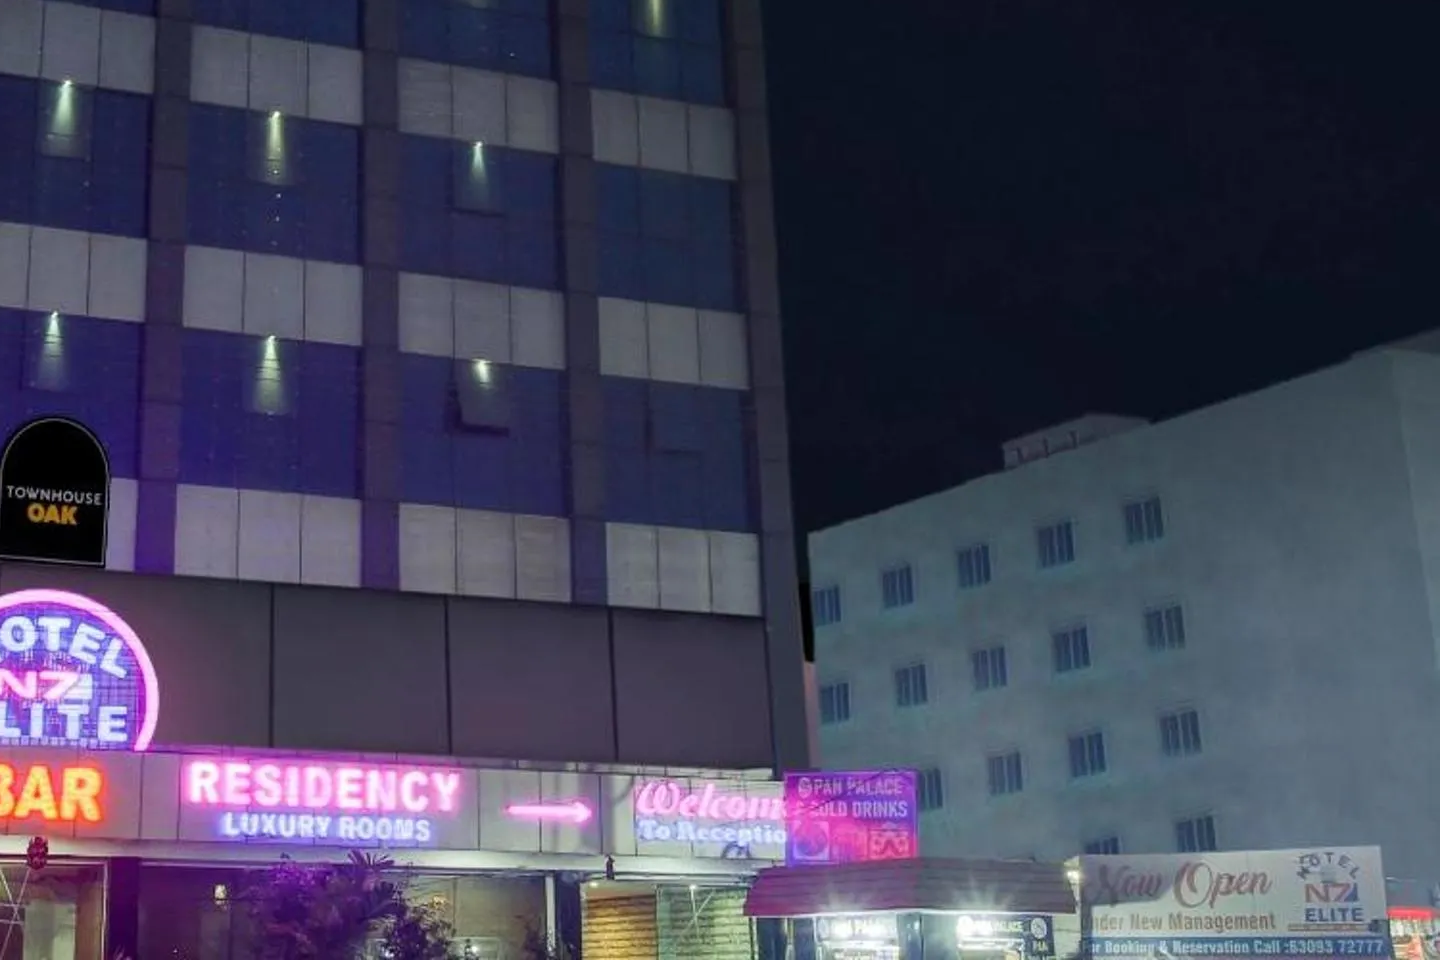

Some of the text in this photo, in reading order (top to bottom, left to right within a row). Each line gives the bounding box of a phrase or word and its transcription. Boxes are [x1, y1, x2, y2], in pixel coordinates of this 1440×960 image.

[6, 485, 103, 506] TOWNHOUSE
[27, 502, 77, 525] OAK
[190, 761, 460, 811] RESIDENCY
[636, 782, 787, 820] Welcom
[851, 800, 908, 818] DRINKS
[223, 812, 431, 840] LUXURY ROOMS
[638, 819, 786, 848] To Receptio
[1296, 851, 1360, 881] HOTEL
[1172, 860, 1272, 909] Open
[1129, 913, 1163, 931] New
[1168, 911, 1277, 934] Management
[1304, 907, 1364, 922] ELITE
[1173, 939, 1250, 955] Reservation
[1253, 939, 1281, 954] Call
